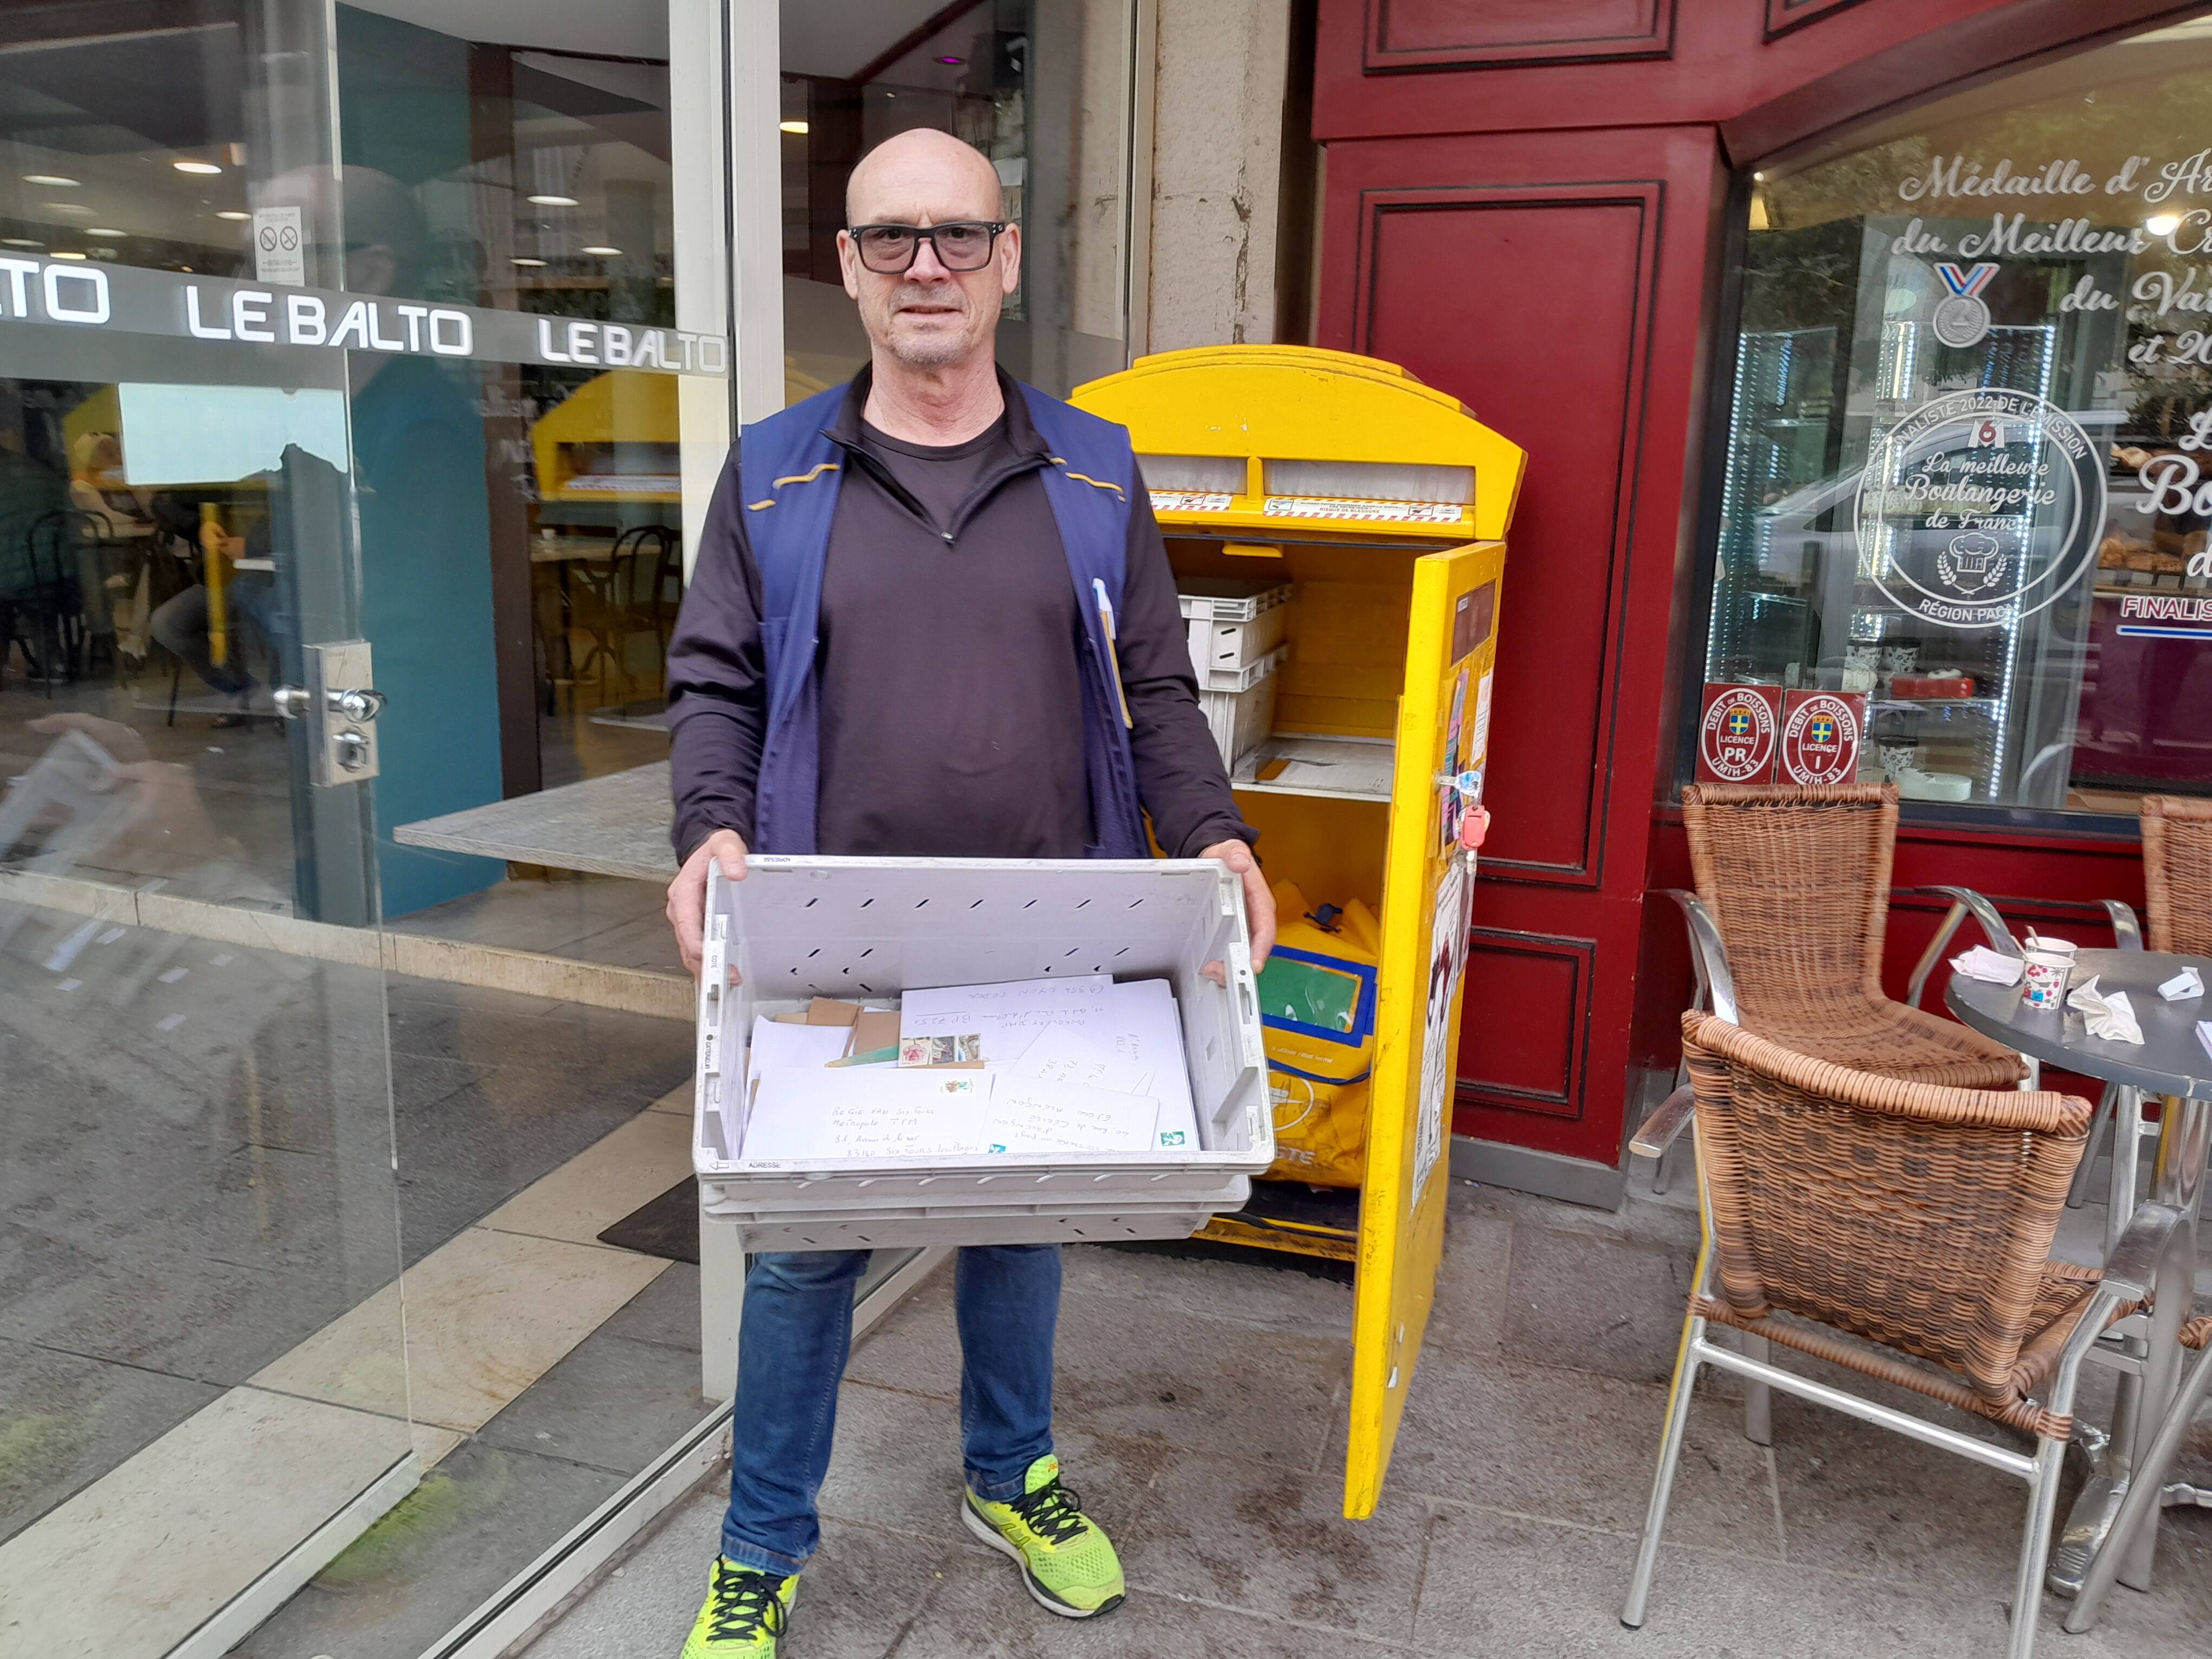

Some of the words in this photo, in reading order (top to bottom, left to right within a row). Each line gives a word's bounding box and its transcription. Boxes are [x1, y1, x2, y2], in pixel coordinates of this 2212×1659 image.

[1898, 155, 2097, 201] Médaille
[1890, 217, 1949, 255] du
[1958, 212, 2153, 259] Meilleur
[0, 258, 110, 324] TO
[2060, 273, 2120, 313] du
[186, 285, 275, 343] LE
[287, 294, 473, 356] BALTO
[538, 318, 600, 365] LE
[602, 325, 726, 373] BALTO
[2127, 334, 2166, 365] et
[1960, 396, 1992, 413] 2022
[1998, 396, 2021, 411] DE
[1922, 451, 1951, 473] La
[1905, 474, 2057, 512] Boulangerie
[1925, 507, 1951, 529] de
[1958, 509, 2025, 531] Franc
[1918, 598, 1973, 622] RÉGION
[1707, 701, 1727, 731] DEBIT
[1737, 693, 1771, 734] BOISSONS
[1789, 709, 1809, 738] DEBIT
[1819, 700, 1854, 742] BOISSONS
[1720, 735, 1755, 745] LICENCE
[1724, 747, 1747, 762] PR
[1802, 742, 1837, 754] LICENCE
[1711, 756, 1759, 777] UMIH-83
[1793, 764, 1842, 785] UMIH-83
